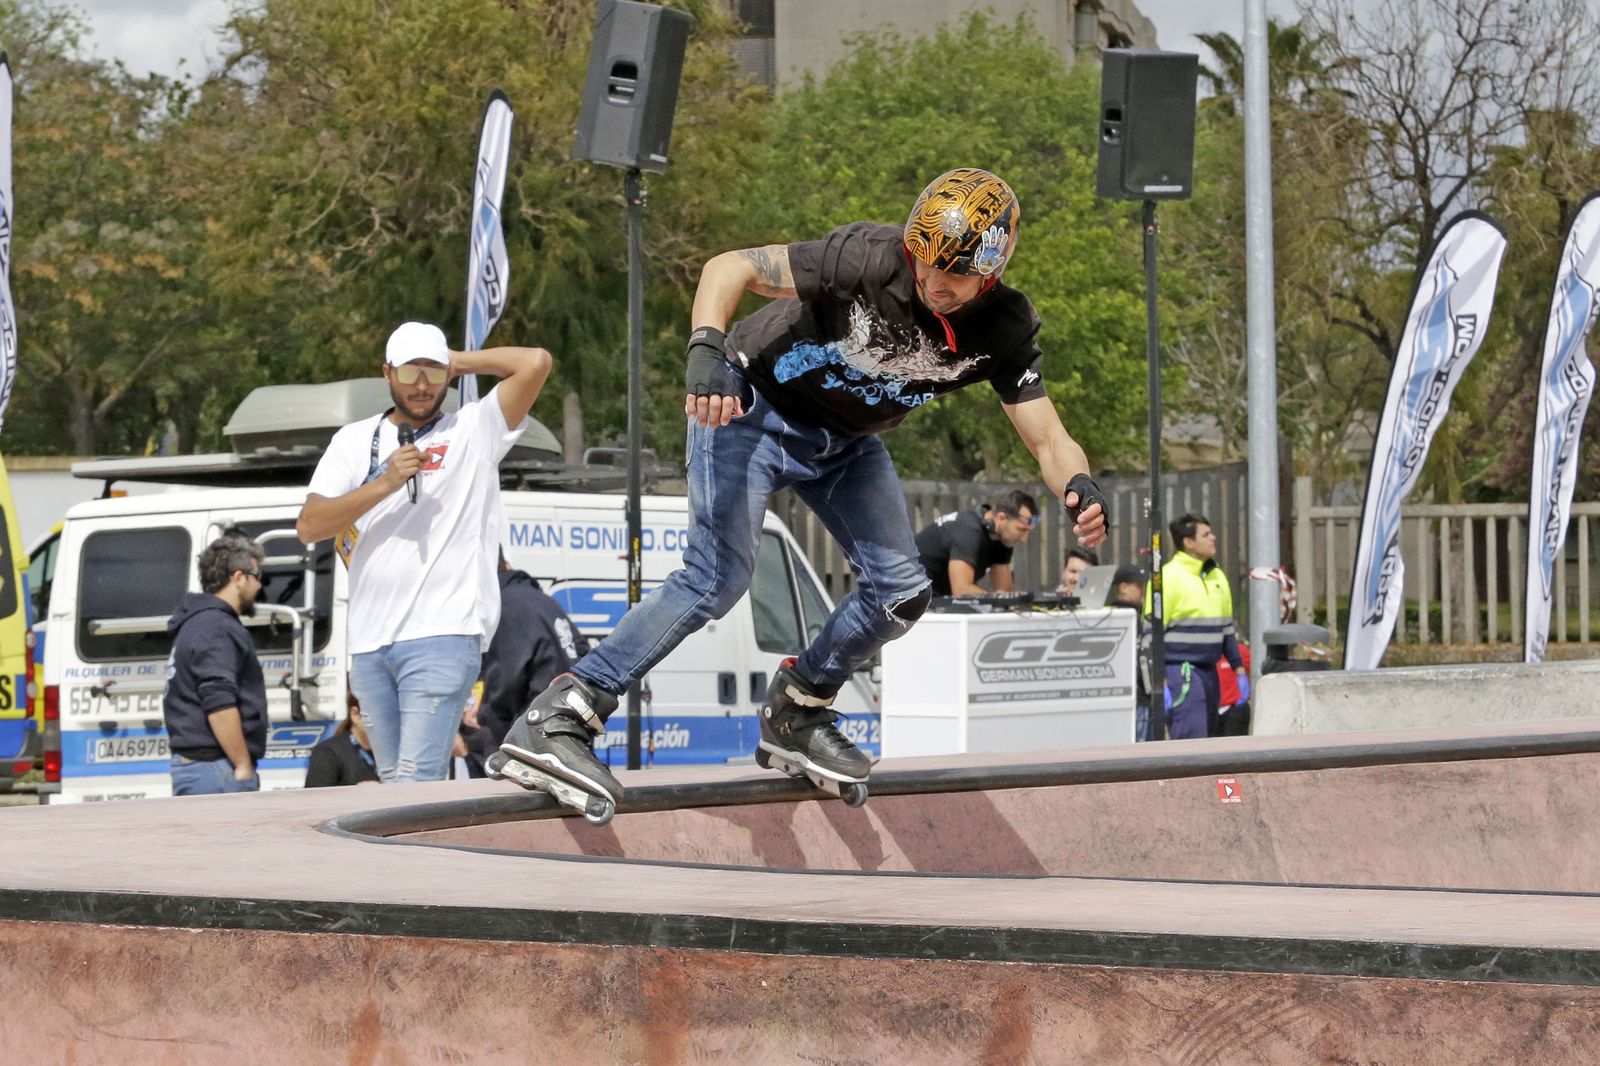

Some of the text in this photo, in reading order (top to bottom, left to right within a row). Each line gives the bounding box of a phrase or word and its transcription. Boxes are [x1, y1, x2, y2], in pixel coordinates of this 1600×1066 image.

[509, 523, 688, 551] MAN SONIO.CO
[974, 628, 1127, 666] GS
[65, 665, 131, 679] ALQUILER
[137, 664, 157, 676] DE
[980, 668, 1035, 682] GERMAN
[97, 738, 168, 759] CA4697B
